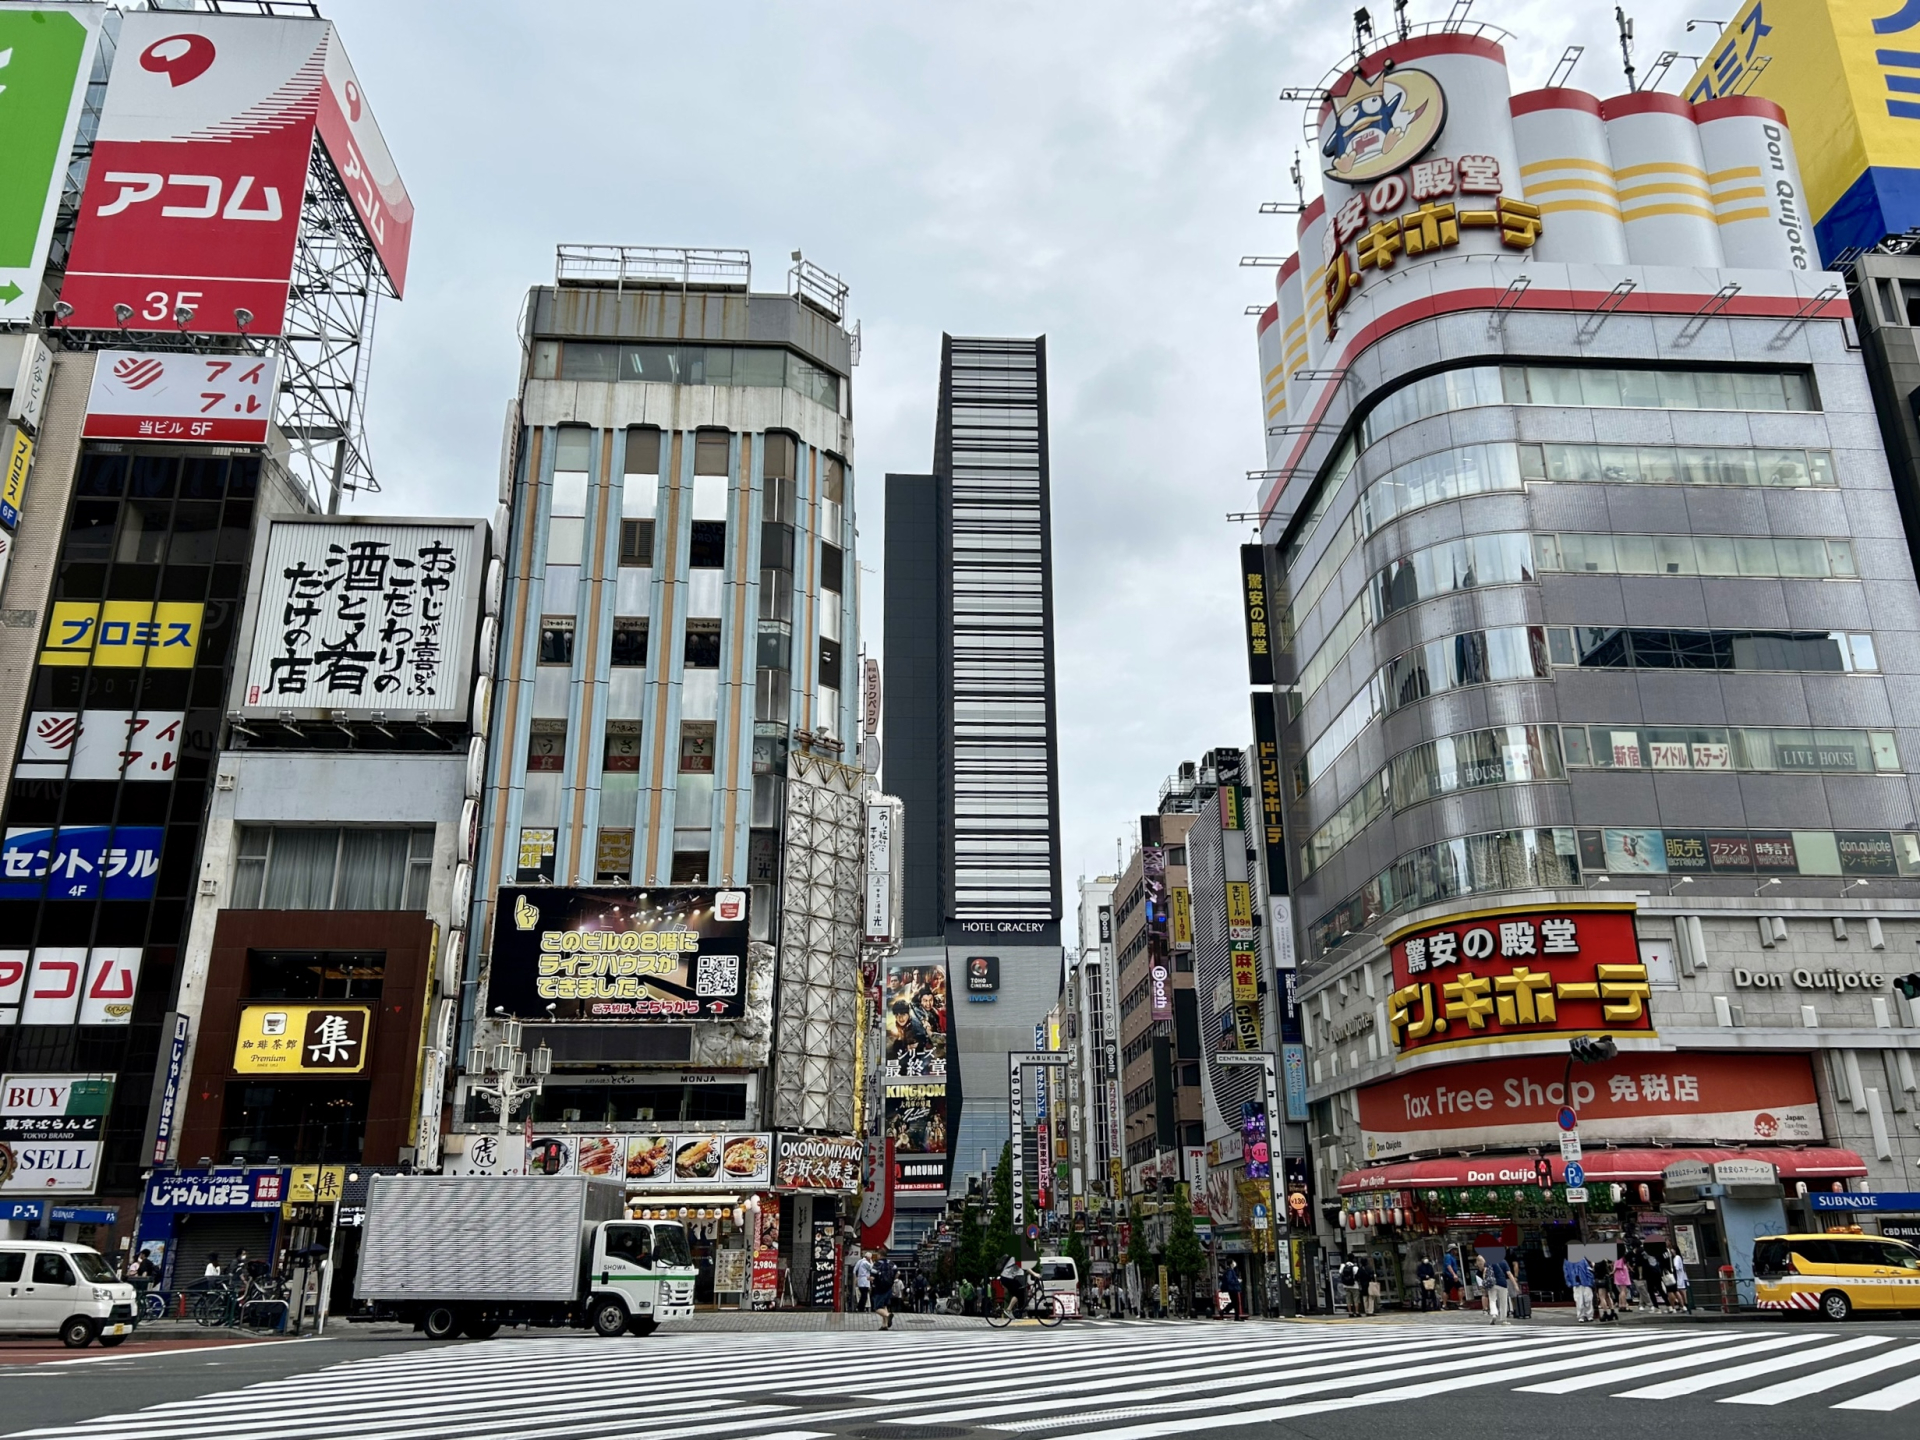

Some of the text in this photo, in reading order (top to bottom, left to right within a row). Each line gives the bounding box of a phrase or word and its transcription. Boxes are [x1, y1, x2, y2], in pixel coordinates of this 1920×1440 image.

[97, 172, 283, 222] アコム
[343, 140, 386, 246] アコム
[1763, 124, 1808, 271] Don Quijote
[142, 291, 203, 321] 3F
[24, 350, 47, 415] 戸谷ビル
[205, 361, 266, 386] アイ
[200, 392, 262, 415] フル
[138, 420, 213, 436] 当ビル 5F
[8, 439, 28, 501] プロミス
[1, 505, 14, 519] 6F
[314, 541, 391, 695] 酒と肴
[1247, 573, 1268, 654] 驚安の殿堂
[62, 616, 192, 647] プロミス
[262, 561, 329, 695] だけの店
[373, 557, 420, 694] こだわりの
[125, 718, 181, 741] アイ
[118, 751, 177, 772] フル
[1613, 744, 1728, 768] 新宿 アイドル ステージ
[1784, 750, 1855, 766] LIVE HOUSE
[1466, 764, 1503, 783] HOUSE
[1666, 838, 1704, 857] 販売
[1710, 842, 1748, 855] ブランド
[1755, 843, 1791, 855] 時計
[2, 847, 160, 878] セントラル
[518, 853, 541, 868] 4F
[1713, 855, 1750, 865] BRAND
[1757, 855, 1794, 866] WATCH
[1841, 855, 1893, 868] ドン・キホーテ
[68, 885, 87, 896] 4F
[1231, 885, 1242, 916] 生ビール
[962, 922, 1045, 932] HOTEL GRACERY
[540, 930, 699, 953] このビルの8階に
[1234, 942, 1249, 951] 4F
[1405, 918, 1580, 974] 驚安の殿堂
[538, 953, 679, 976] ライブハウスが
[1235, 953, 1253, 986] 麻雀
[536, 976, 649, 999] できました。
[1733, 967, 1886, 993] Don Quijote
[592, 1001, 699, 1014] ご予約は、こちらから
[1236, 1005, 1261, 1051] CASIN
[1330, 1011, 1373, 1044] Don Quijote
[307, 1014, 357, 1063] 集
[250, 1054, 287, 1063] Premium
[897, 1047, 937, 1060] シリーズ
[885, 1058, 947, 1077] 最終章
[680, 1075, 717, 1083] MONJA
[1608, 1074, 1699, 1103] 免税店
[6, 1087, 67, 1107] BUY
[886, 1084, 946, 1098] KINGDOM
[1404, 1077, 1596, 1120] Tax Free Shop
[1785, 1114, 1807, 1122] Japan.
[1012, 1077, 1023, 1210] GODZILLA ROAD
[1793, 1129, 1810, 1137] Shop
[20, 1149, 92, 1170] SELL
[780, 1142, 863, 1161] OKONOMIYAKI
[785, 1158, 854, 1180] お好み焼き
[904, 1164, 944, 1176] MARUHAN
[1467, 1169, 1537, 1182] Don Quijo
[1667, 1168, 1703, 1178] 安全安心ステーショ
[1717, 1166, 1770, 1174] 安全安心ステーション
[259, 1177, 279, 1187] 買取
[319, 1171, 340, 1197] 集
[151, 1185, 249, 1206] じゃんぱら
[258, 1188, 278, 1198] 販売
[1818, 1195, 1878, 1207] SUBNADE
[12, 1205, 23, 1218] P
[1883, 1227, 1920, 1236] CBD HILL
